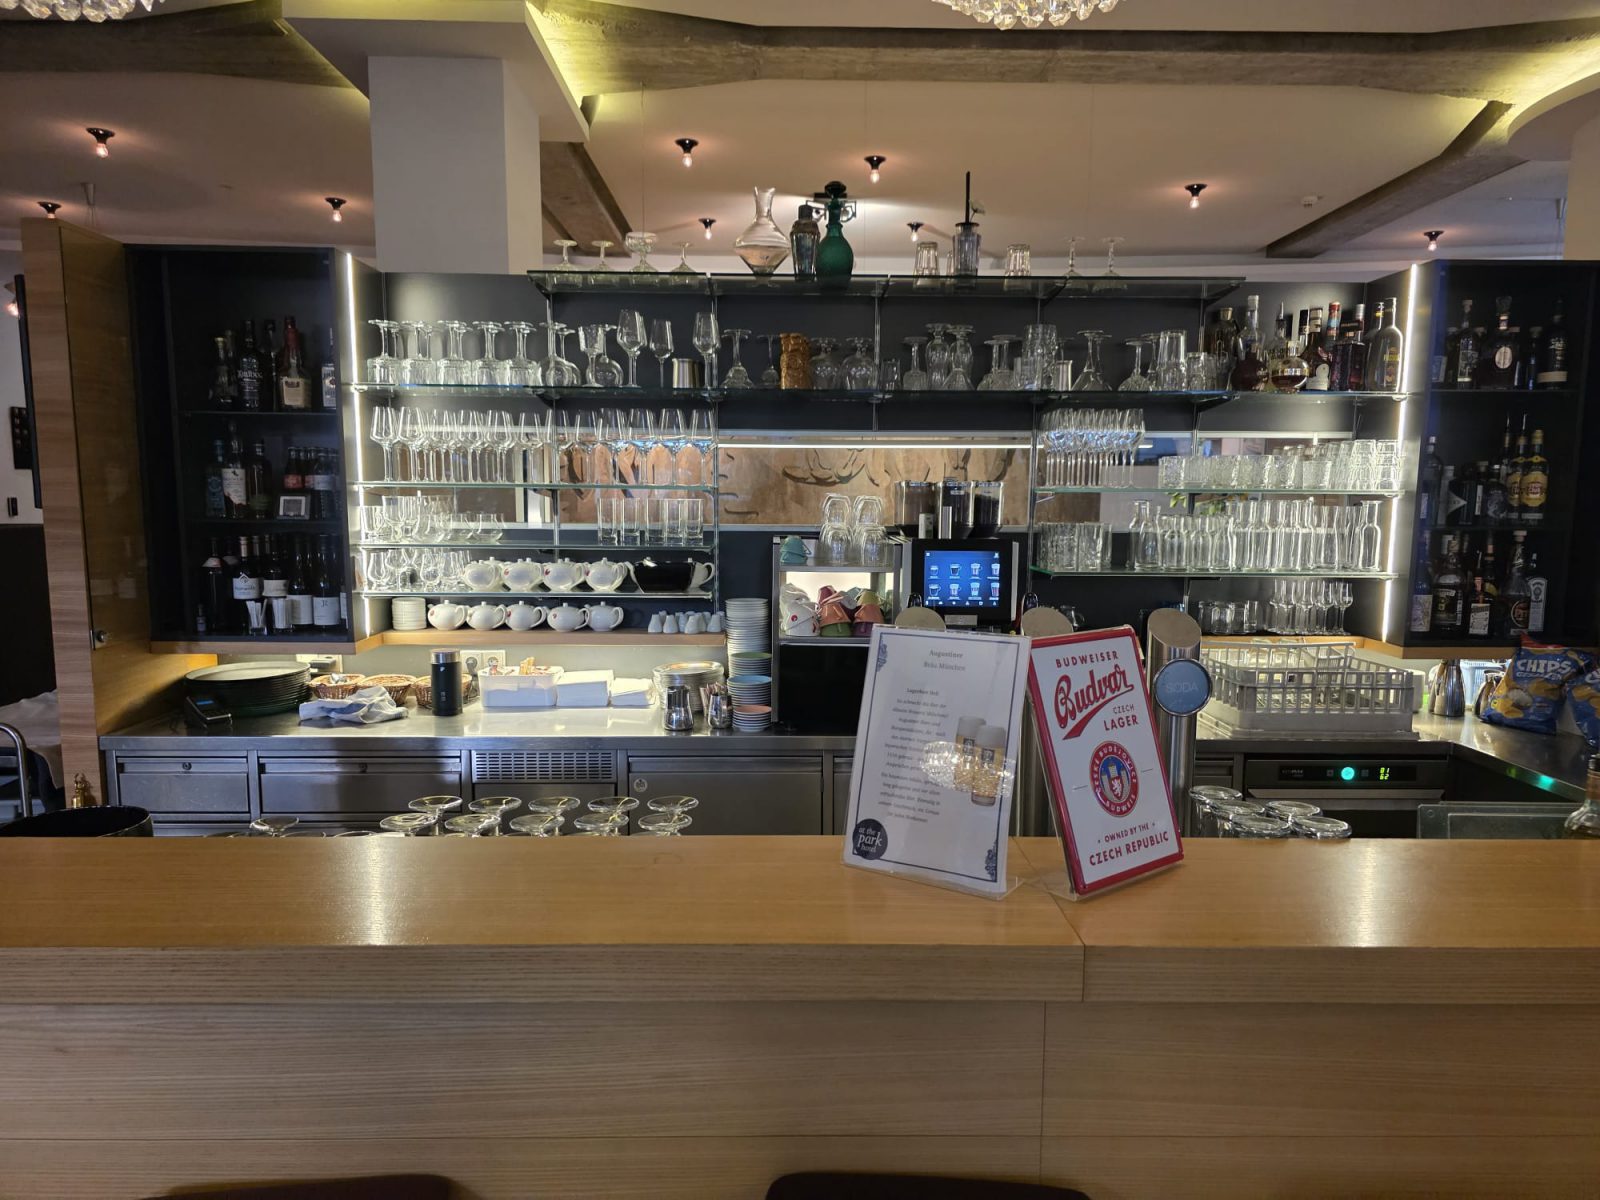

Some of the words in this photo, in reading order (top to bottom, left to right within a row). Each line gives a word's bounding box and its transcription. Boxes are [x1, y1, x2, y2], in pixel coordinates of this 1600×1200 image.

[929, 649, 964, 659] Augustiner
[1055, 650, 1119, 668] BUDWEISER
[1516, 659, 1572, 674] CHIPS
[1054, 663, 1134, 729] Budvar
[1166, 682, 1198, 693] SODA
[1112, 704, 1135, 714] CZECH
[1103, 714, 1139, 731] LAGER
[857, 831, 883, 848] park
[1104, 829, 1129, 843] OWNED
[1129, 826, 1137, 835] BY
[1138, 822, 1150, 832] THE
[1089, 846, 1123, 866] CZECH
[1125, 831, 1169, 855] REPUBLIC
